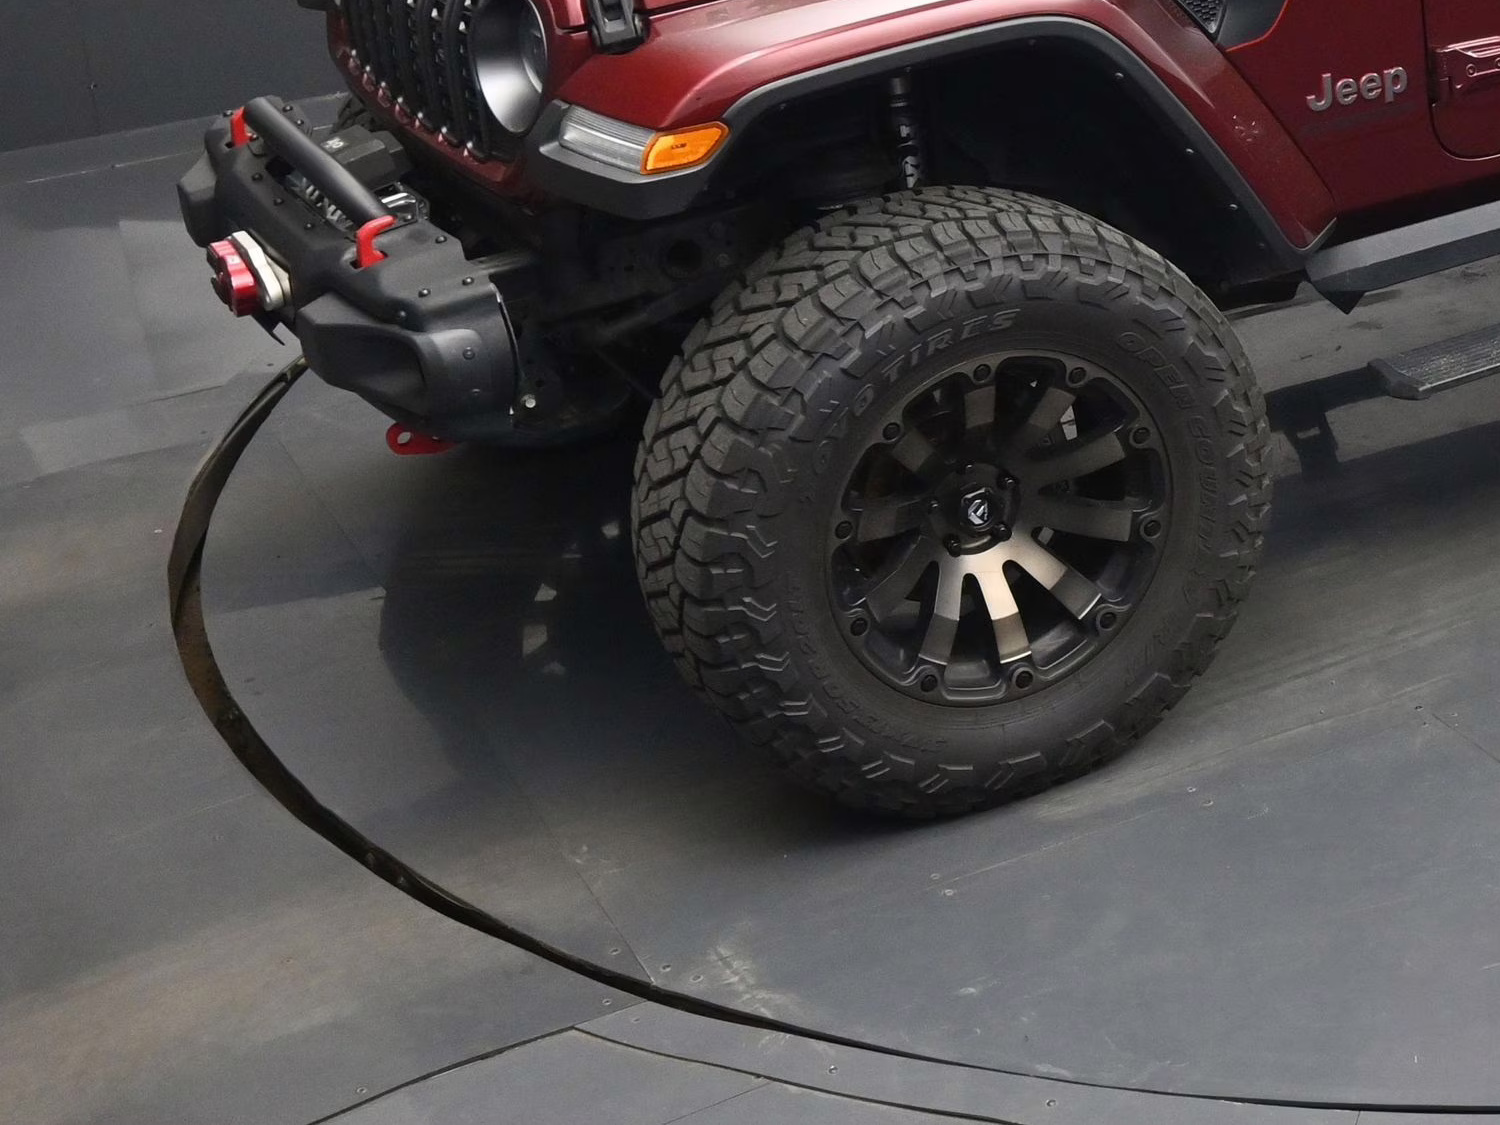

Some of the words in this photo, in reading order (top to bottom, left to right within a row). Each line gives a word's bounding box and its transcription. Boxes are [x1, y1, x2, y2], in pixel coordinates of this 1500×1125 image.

[1306, 66, 1408, 112] Jeep
[881, 308, 1021, 383] TIRES
[1116, 331, 1196, 410] OPEN
